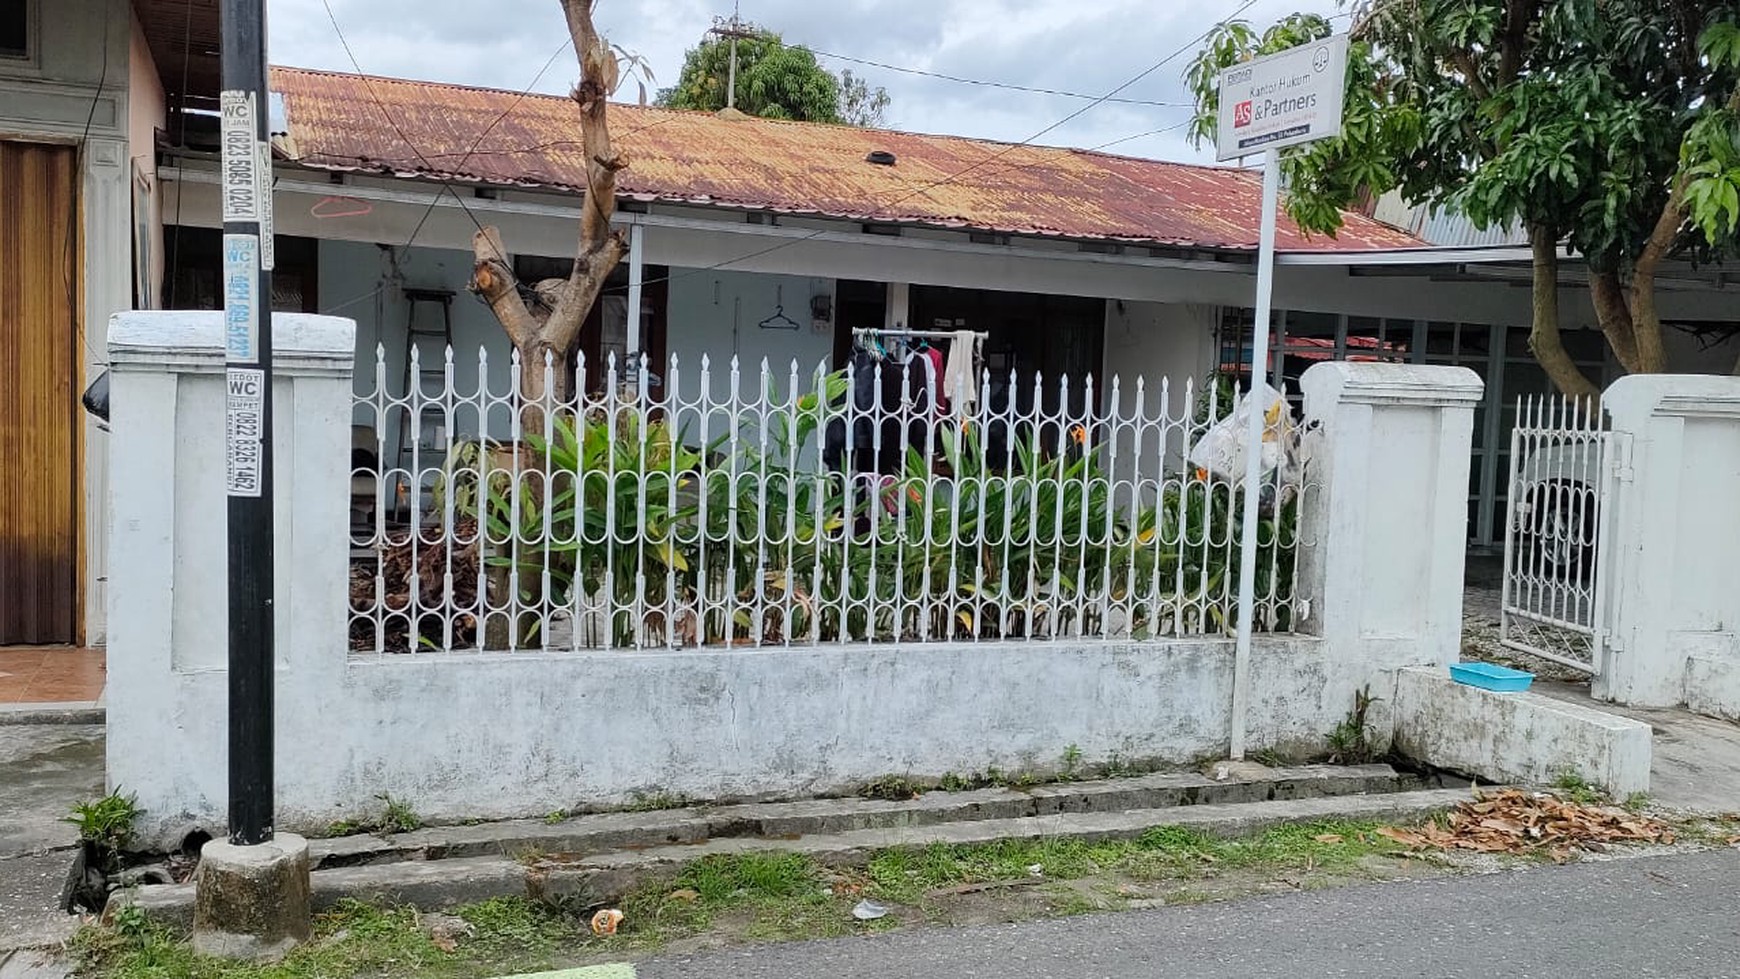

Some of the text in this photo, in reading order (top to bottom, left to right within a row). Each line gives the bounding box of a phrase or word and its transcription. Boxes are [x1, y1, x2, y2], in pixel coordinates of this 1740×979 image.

[1249, 73, 1311, 99] Kantor Hukum
[222, 105, 248, 117] WC
[1235, 103, 1251, 124] AS
[226, 130, 252, 156] 0823
[229, 188, 254, 214] 0204
[227, 250, 250, 262] WC
[229, 381, 257, 395] WC
[234, 411, 257, 490] 0822 8326 1462
